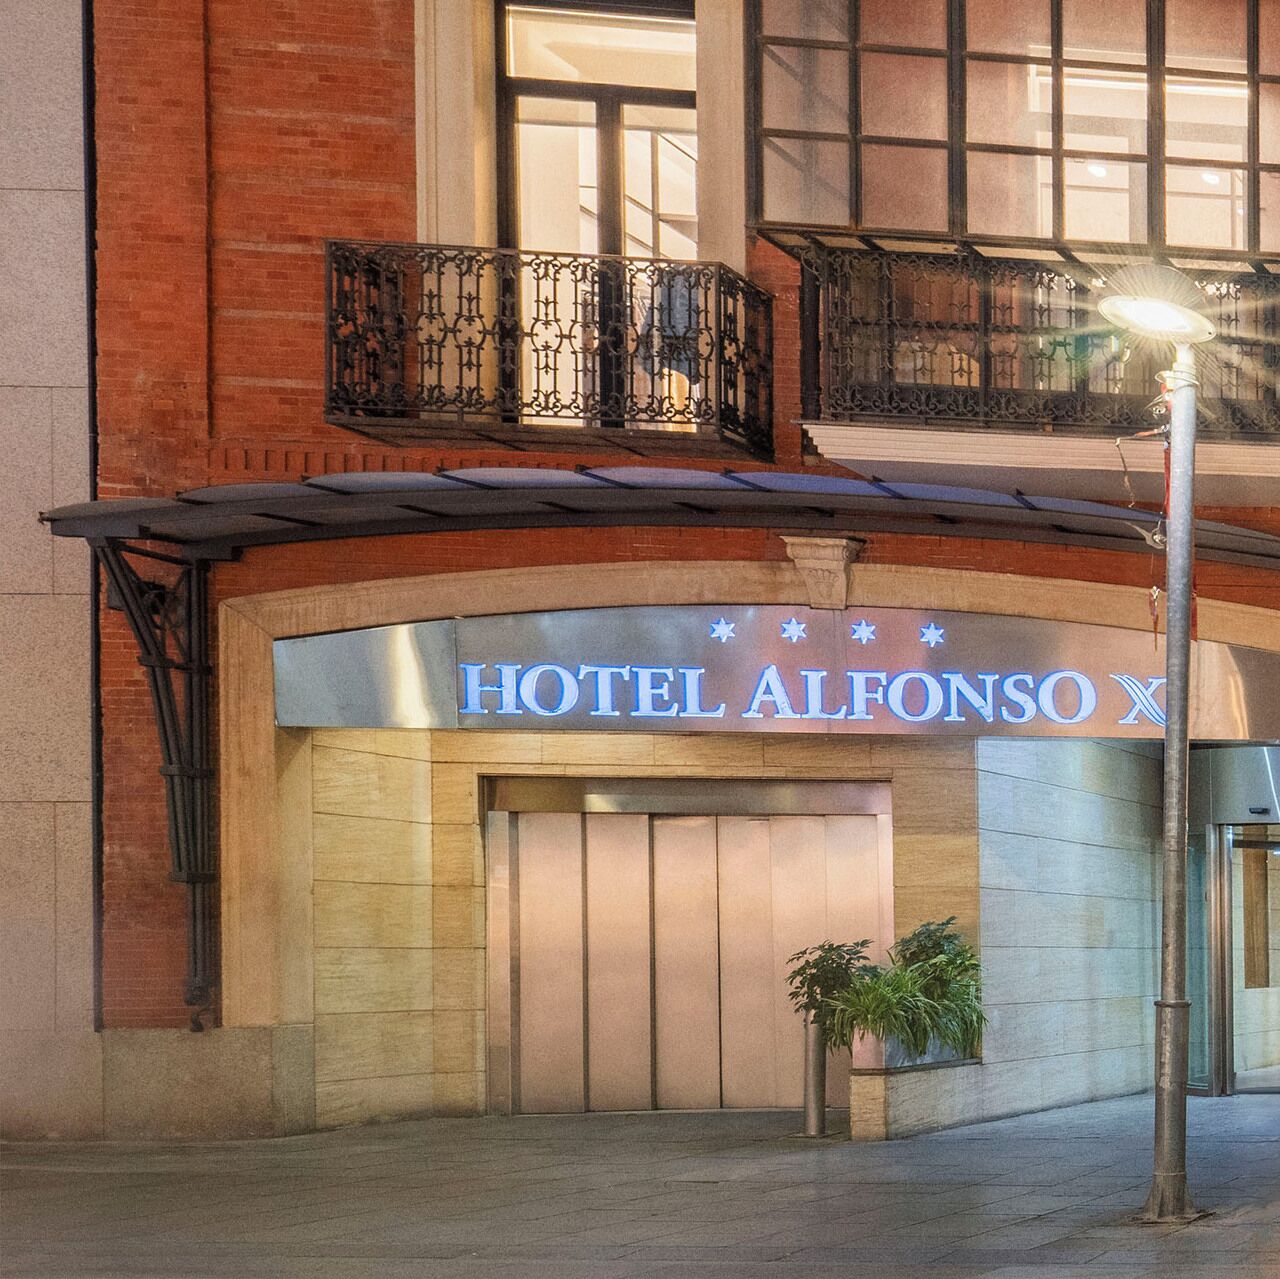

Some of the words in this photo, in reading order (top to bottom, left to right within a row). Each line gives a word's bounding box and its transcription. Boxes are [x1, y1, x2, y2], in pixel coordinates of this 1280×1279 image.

[459, 663, 727, 718] HOTEL
[742, 664, 1098, 725] ALFONSO
[1108, 672, 1168, 728] X
